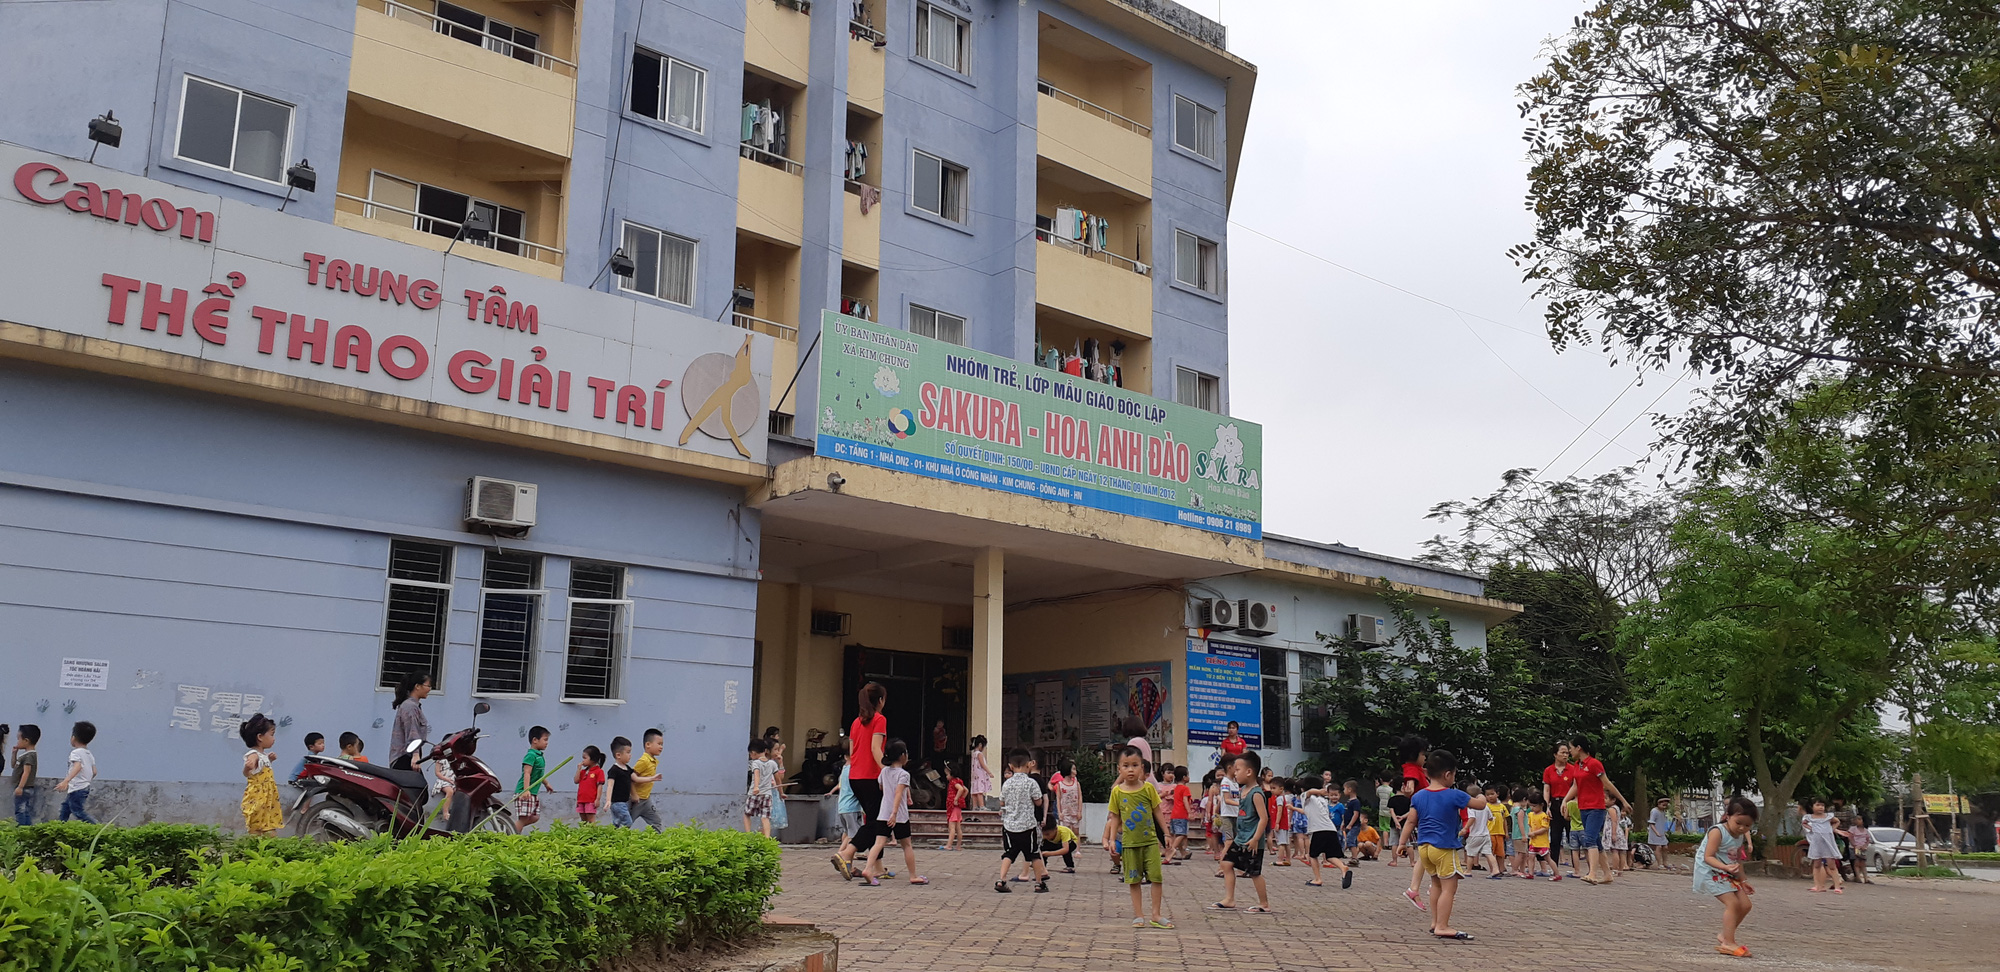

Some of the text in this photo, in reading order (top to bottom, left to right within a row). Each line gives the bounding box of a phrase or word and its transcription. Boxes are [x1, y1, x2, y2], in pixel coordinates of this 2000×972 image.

[14, 162, 214, 242] Canon
[304, 252, 538, 334] TRUNG TÂM
[102, 271, 673, 430] THỂ THAO GIẢI TRÍ
[835, 318, 918, 353] ỦY BAN NHÂN DÂN
[859, 347, 877, 361] KIM
[879, 353, 910, 369] CHUNG
[946, 354, 1166, 425] NHÓM TRẺ, LỚP MẪU GIÁO ĐỘC LẬP
[919, 382, 1189, 483] SAKURA - HOA ANH ĐÀO
[870, 451, 875, 460] 1
[880, 451, 894, 464] NHÀ
[895, 455, 909, 466] DN2
[925, 461, 939, 472] KHU
[940, 464, 954, 475] NHÀ
[961, 468, 979, 480] CÔNG
[980, 472, 998, 484] NHÂN
[1002, 476, 1013, 487] KIM
[1015, 479, 1035, 491] CHUNG
[1040, 483, 1056, 495] ĐÔNG
[1057, 488, 1070, 498] ANH
[1074, 490, 1082, 500] HN
[945, 440, 957, 454] SỐ
[958, 445, 982, 459] QUYẾT
[984, 451, 1005, 466] ĐỊNH:
[1007, 456, 1033, 471] 150/QĐ
[1040, 462, 1060, 476] UBND
[1062, 465, 1076, 479] CẤP
[1078, 470, 1097, 484] NGÀY
[1099, 475, 1108, 486] 12
[1109, 477, 1131, 491] THÁNG
[1133, 482, 1141, 493] 09
[1142, 483, 1158, 496] NĂM
[1160, 487, 1176, 500] 2012
[1178, 510, 1205, 524] Hotline:
[1225, 520, 1233, 529] 21
[1205, 656, 1246, 668] TIẾNG ANH
[1125, 802, 1147, 831] BOY
